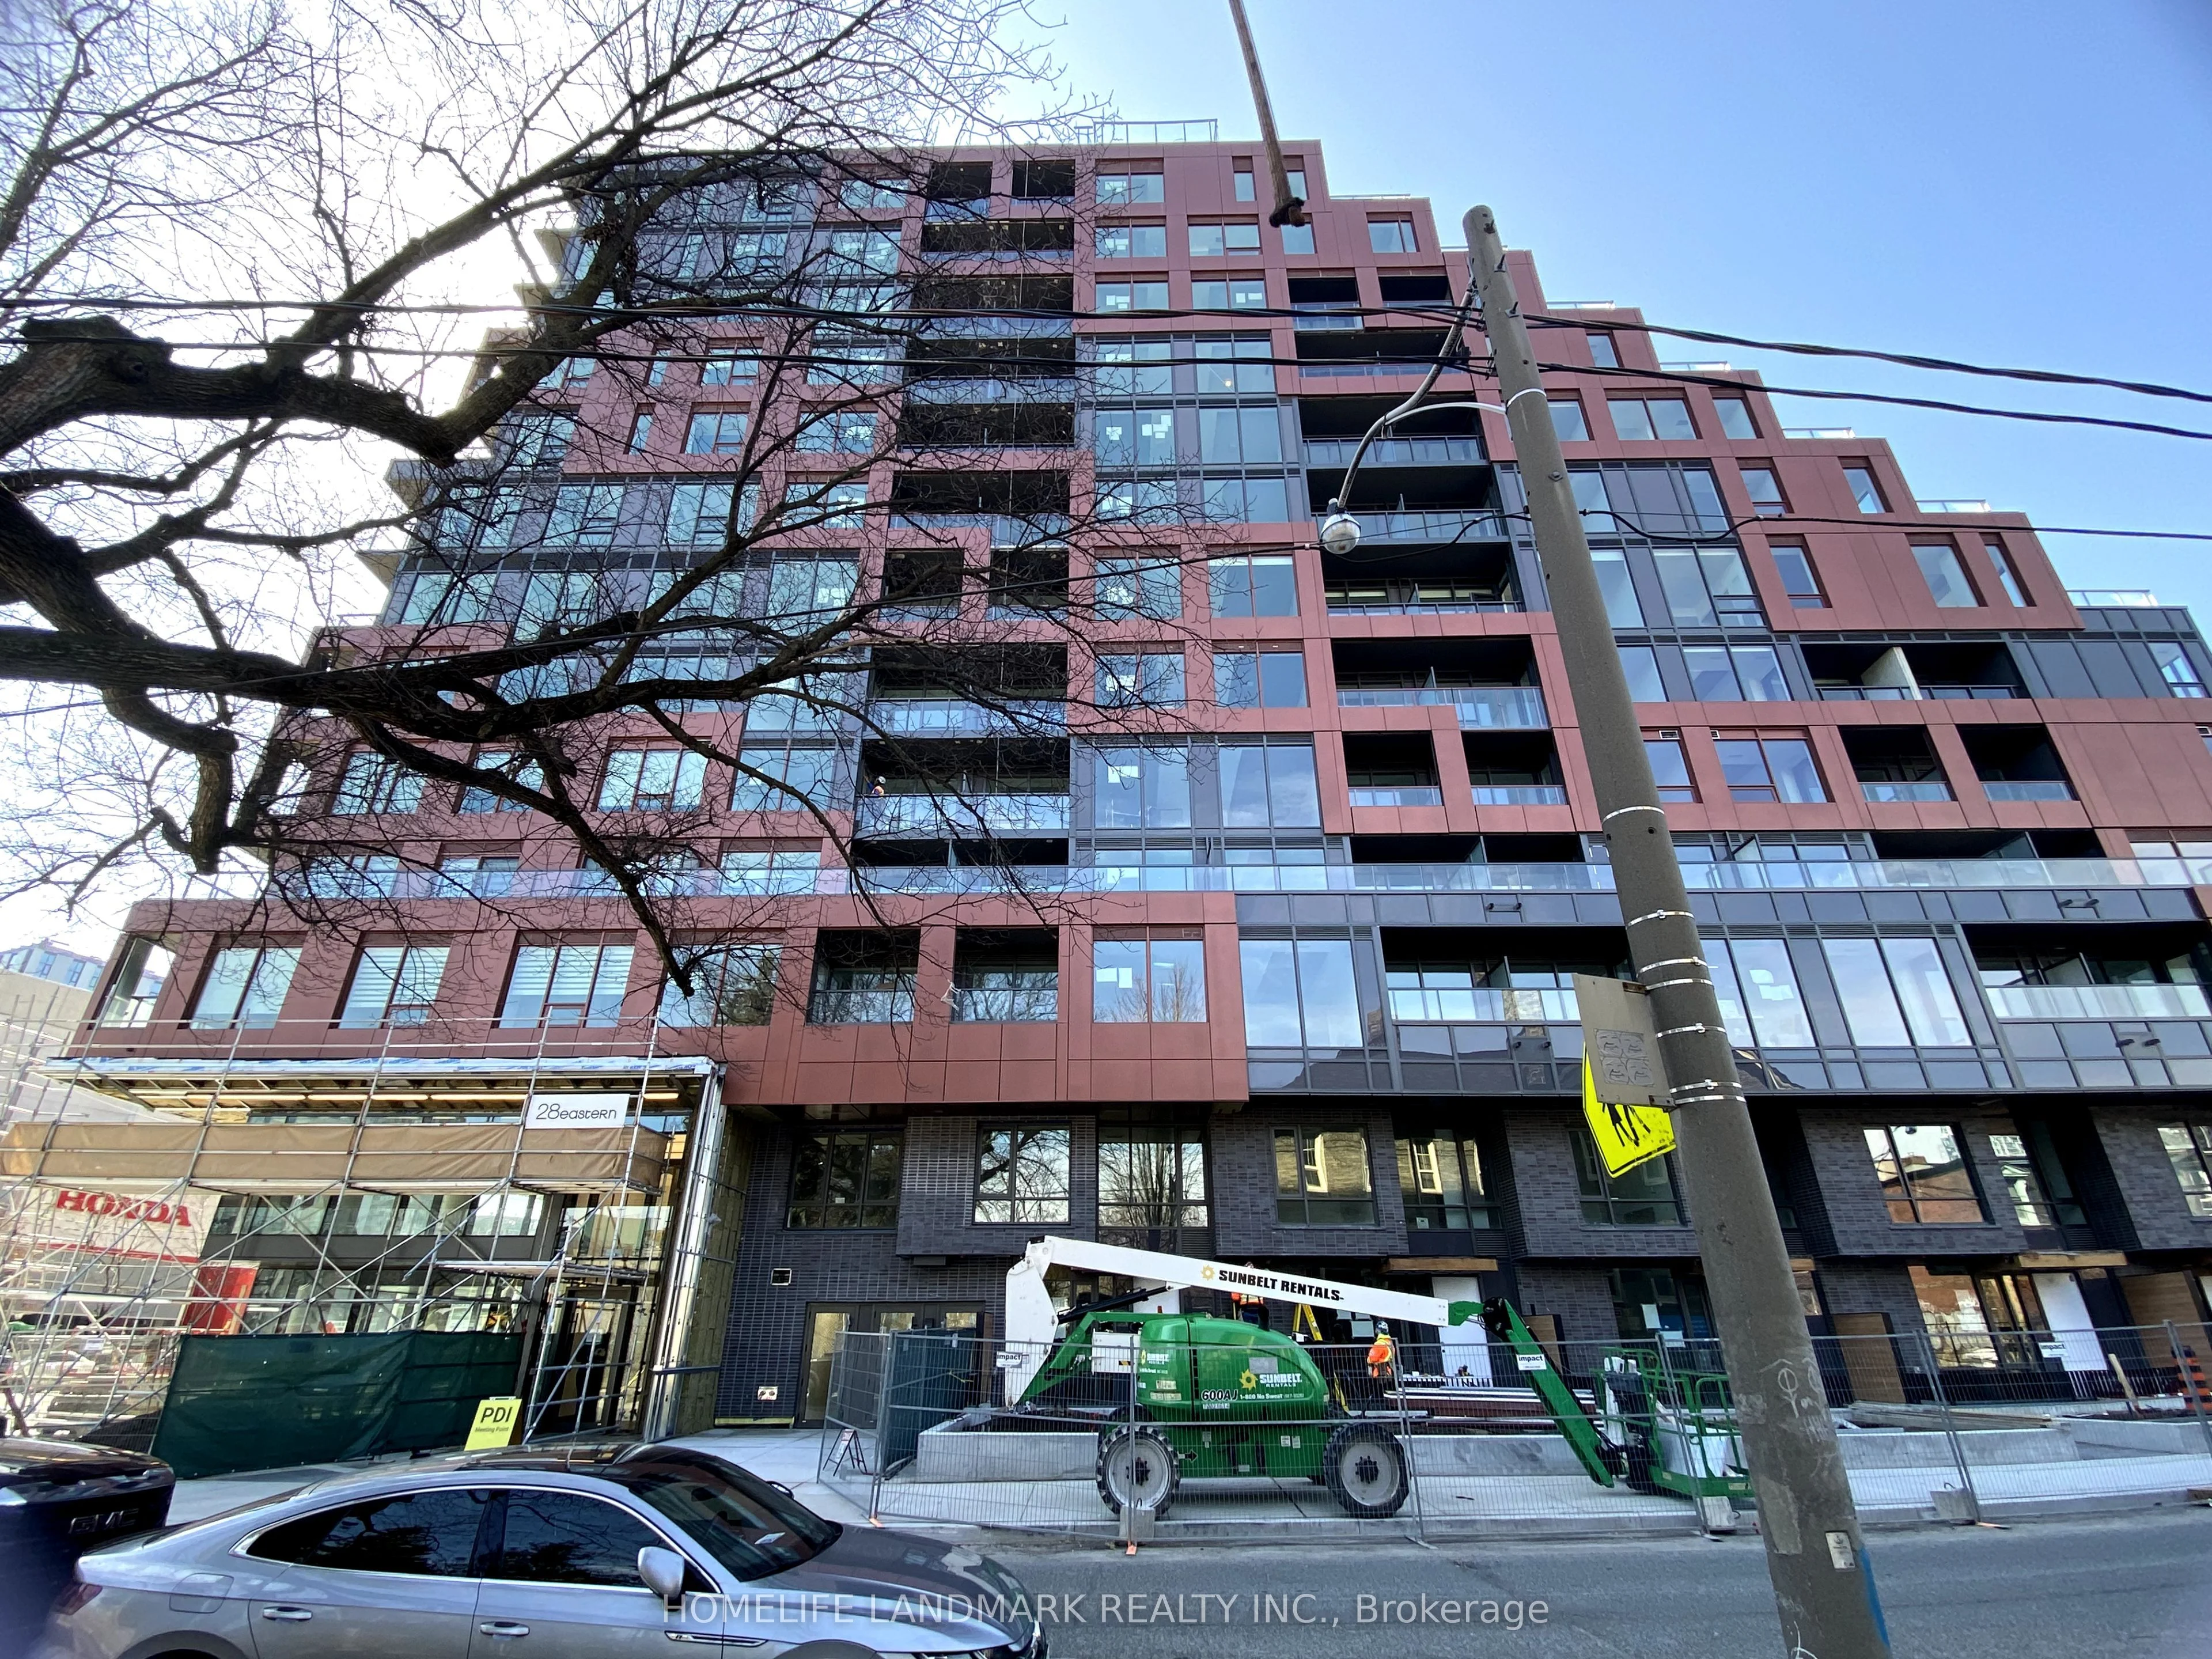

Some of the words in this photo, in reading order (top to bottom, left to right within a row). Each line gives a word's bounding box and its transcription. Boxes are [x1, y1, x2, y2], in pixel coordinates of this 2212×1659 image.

[56, 1190, 191, 1226] HONDA
[1218, 1270, 1278, 1290] SUNBELT
[1281, 1280, 1341, 1301] RENTALS
[1259, 1373, 1302, 1383] SUNBELT
[1201, 1389, 1238, 1402] 600AJ
[480, 1407, 513, 1423] PDI
[68, 1508, 139, 1534] GMC
